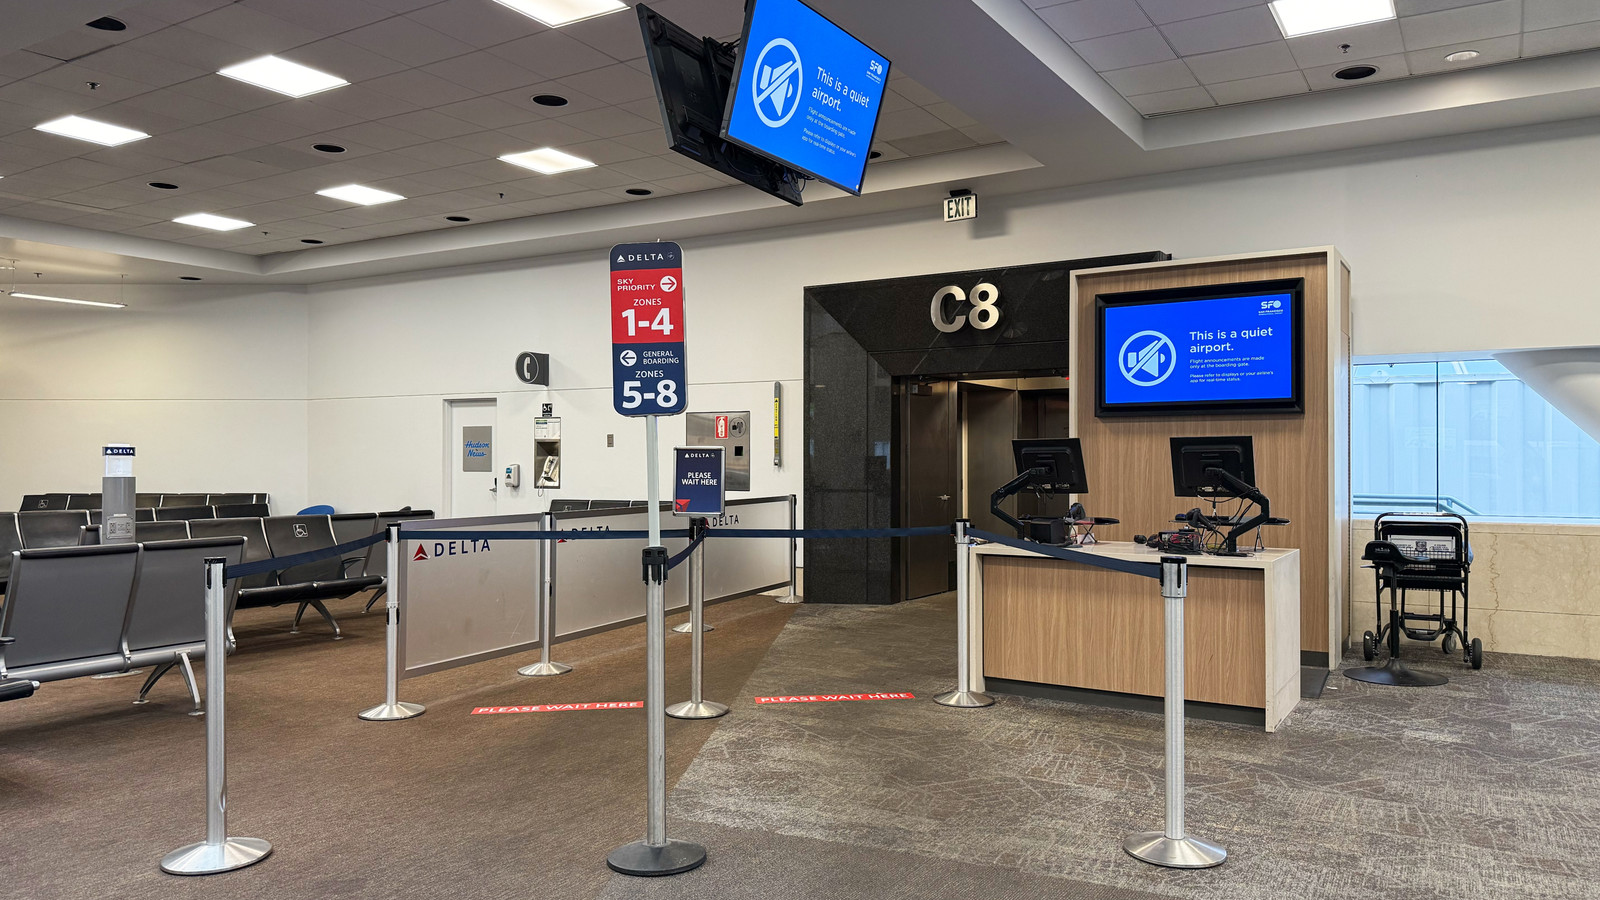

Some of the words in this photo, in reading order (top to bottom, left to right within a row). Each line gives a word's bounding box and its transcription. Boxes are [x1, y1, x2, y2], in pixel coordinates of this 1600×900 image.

[817, 66, 834, 87] This
[834, 78, 842, 92] is
[842, 86, 848, 96] a
[850, 90, 870, 108] quiet
[812, 87, 842, 112] airport.
[948, 196, 972, 218] EXIT
[628, 254, 664, 262] DELTA
[634, 298, 662, 306] ZONES
[930, 282, 1000, 333] C8
[1261, 300, 1281, 309] SFO
[622, 308, 674, 336] 1-4
[1189, 331, 1214, 340] This
[1217, 330, 1226, 339] is
[1241, 327, 1273, 339] quiet
[1190, 342, 1234, 354] airport.
[635, 370, 664, 378] ZONES
[622, 379, 678, 409] 5-8
[713, 515, 739, 527] DELTA
[434, 540, 490, 557] DELTA
